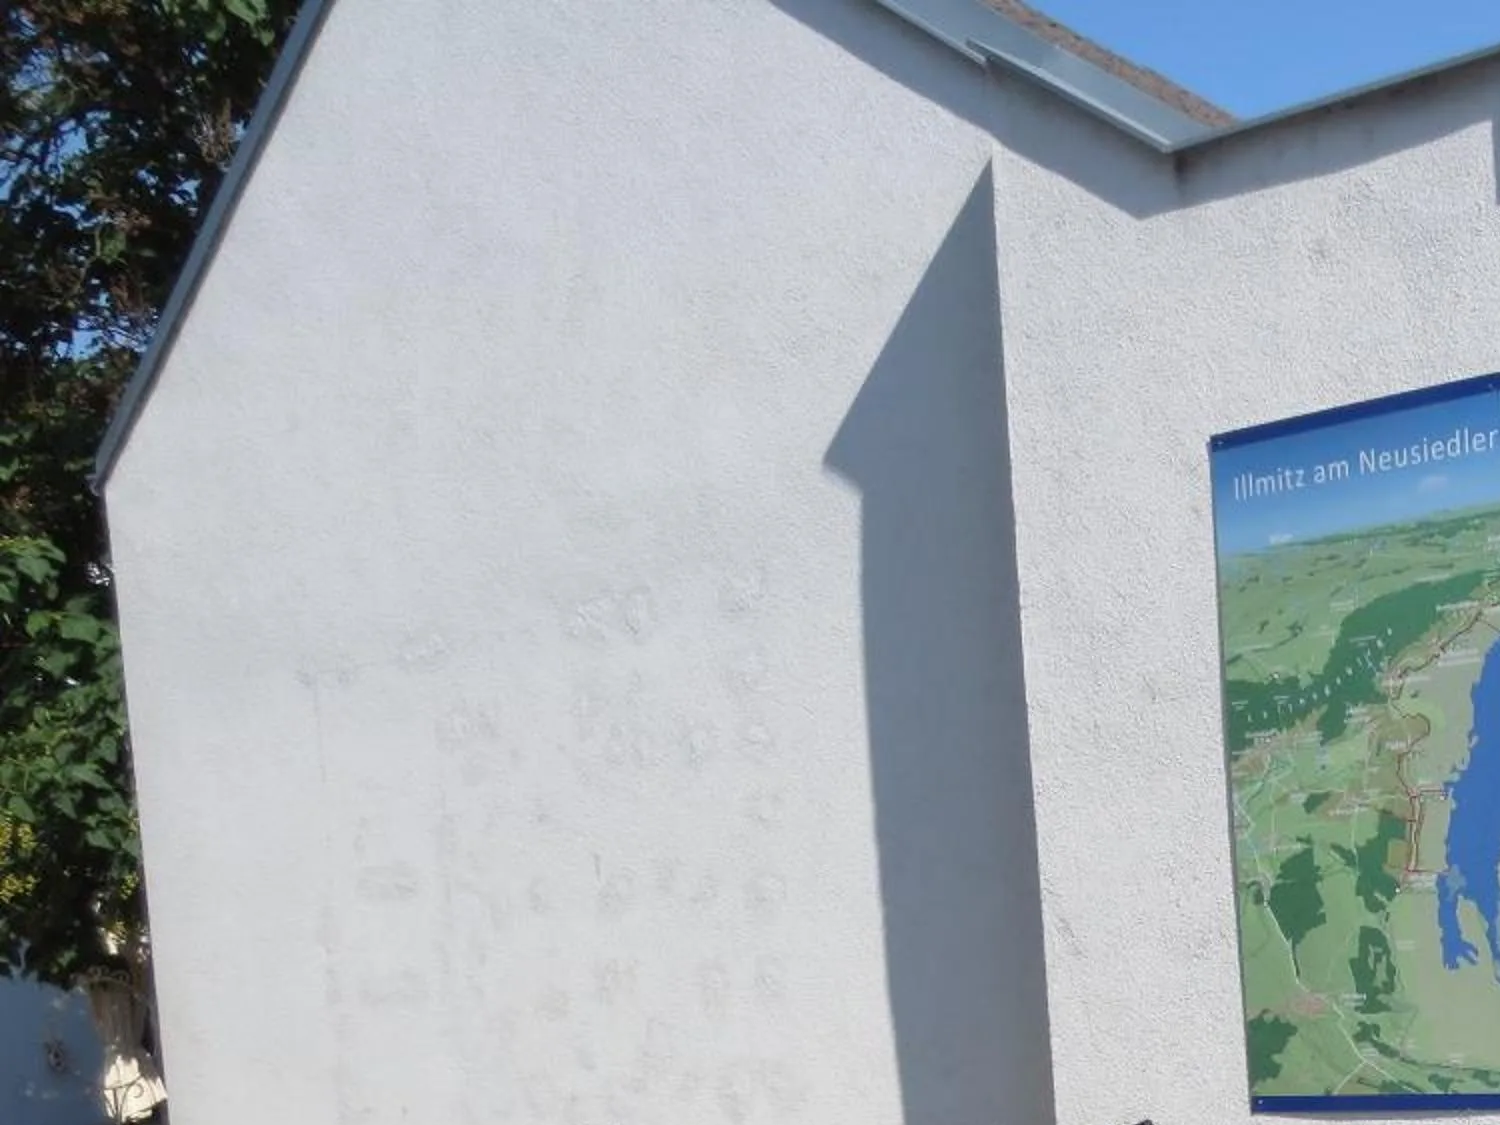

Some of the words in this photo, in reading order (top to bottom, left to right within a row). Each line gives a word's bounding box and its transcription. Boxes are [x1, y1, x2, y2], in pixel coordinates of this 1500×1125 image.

[1234, 467, 1306, 501] Illmitz
[1313, 458, 1350, 485] am
[1358, 427, 1500, 476] Neusiedler
